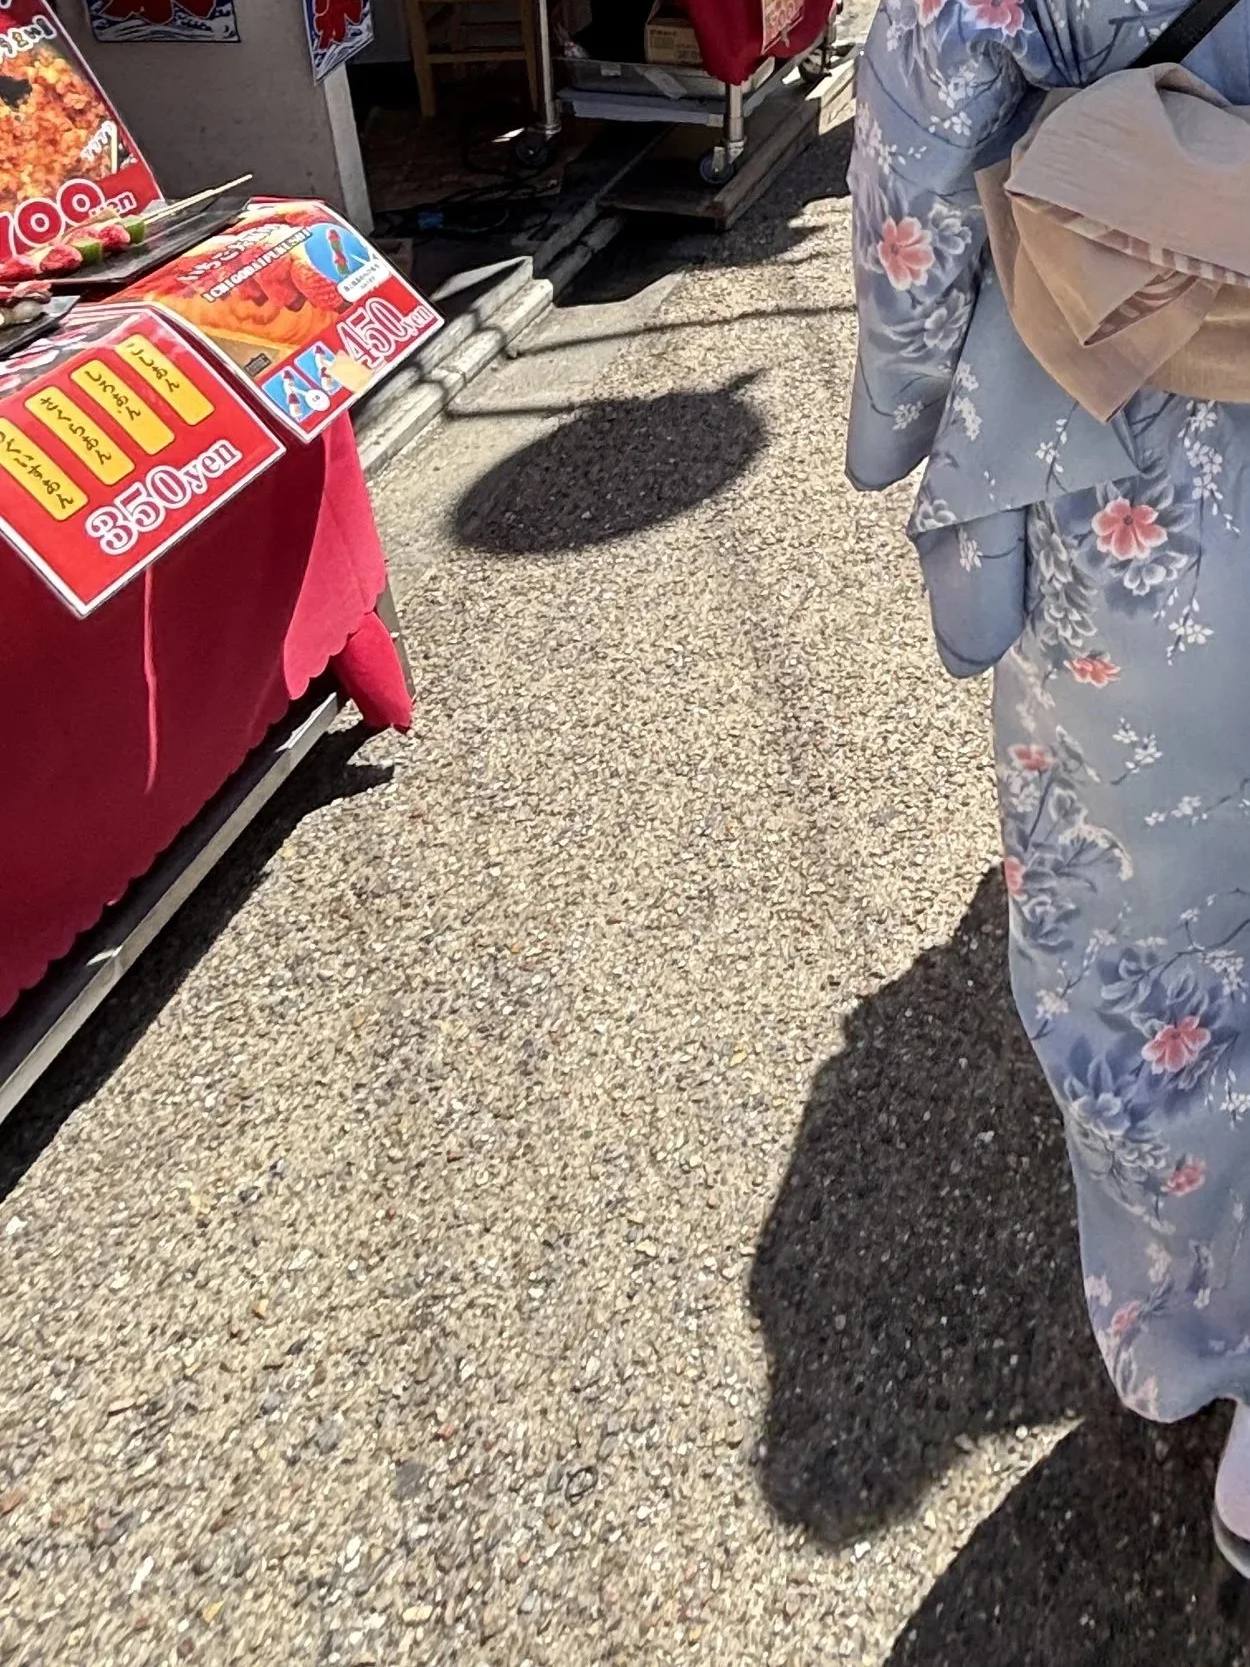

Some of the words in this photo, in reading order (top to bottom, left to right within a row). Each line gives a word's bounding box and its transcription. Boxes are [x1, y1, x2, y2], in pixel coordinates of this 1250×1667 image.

[126, 343, 180, 393] こしあん
[84, 370, 141, 422] しろあん
[39, 396, 112, 466] さくらあん
